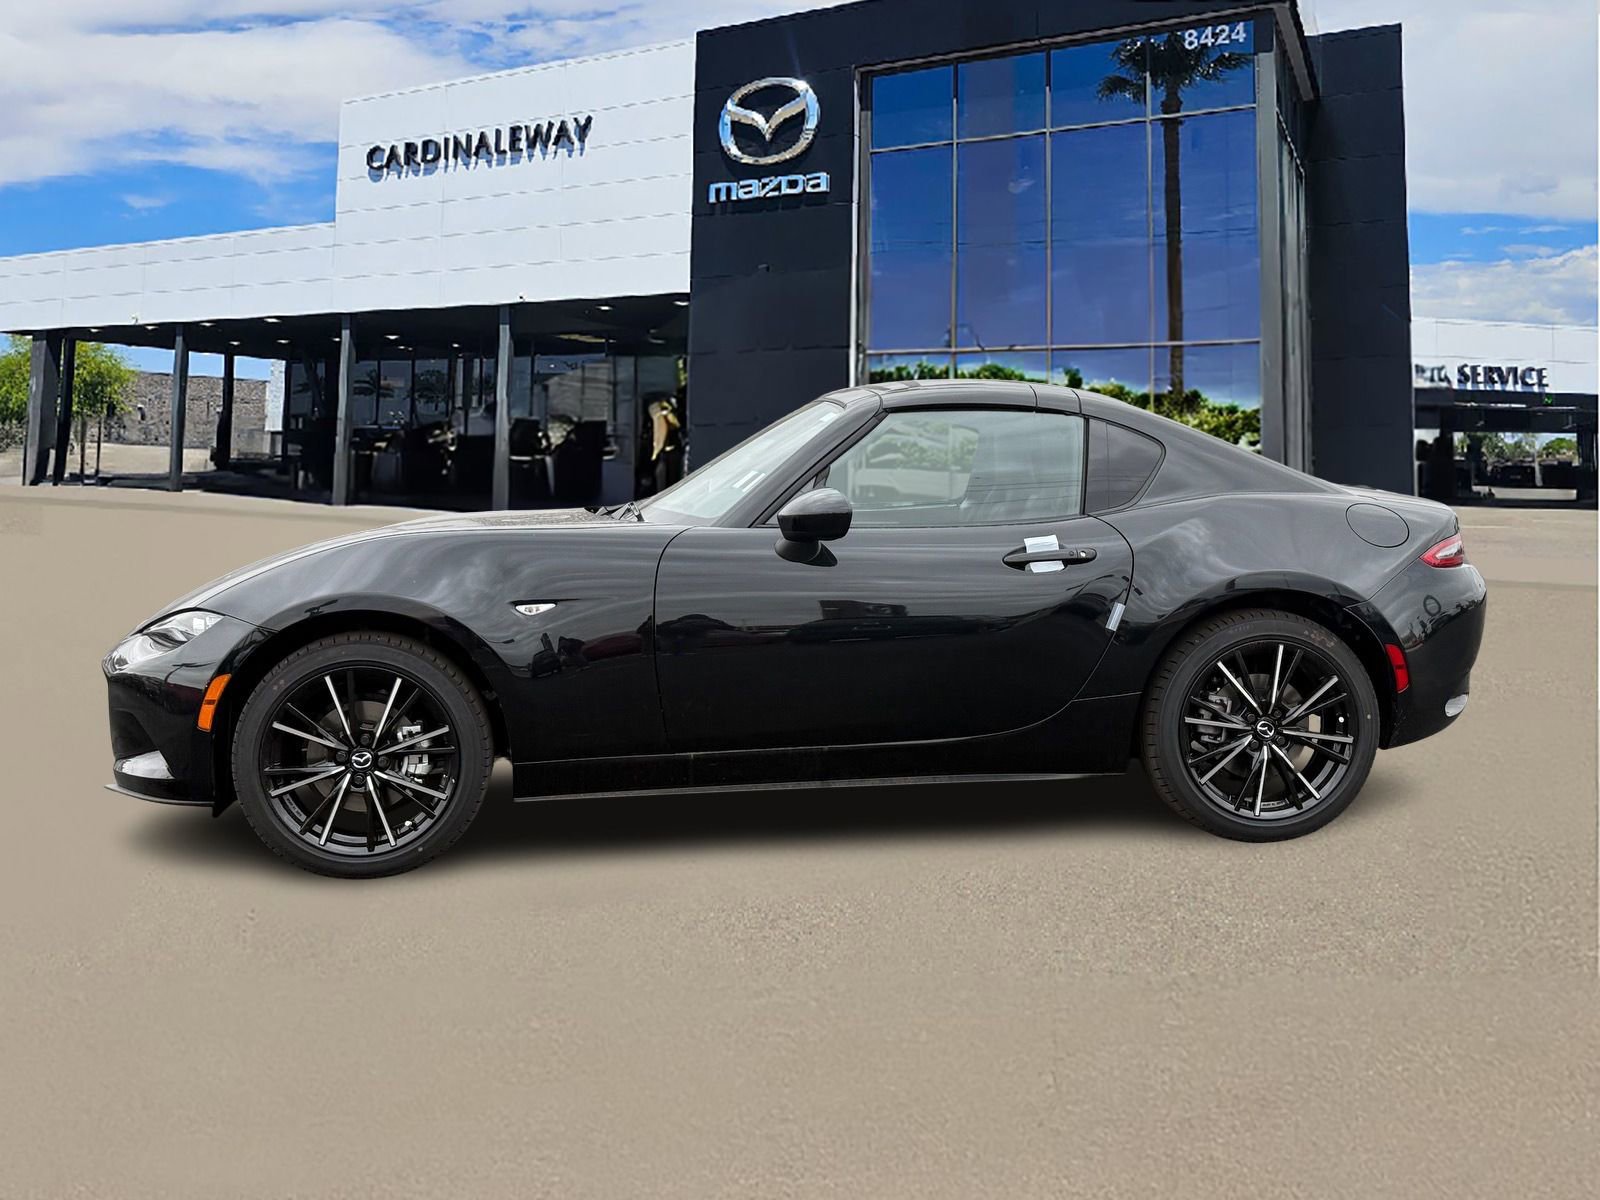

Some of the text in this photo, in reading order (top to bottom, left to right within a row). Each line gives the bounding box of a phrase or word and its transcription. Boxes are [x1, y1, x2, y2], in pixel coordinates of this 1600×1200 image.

[1184, 22, 1246, 50] 8424
[366, 115, 593, 170] CARDINALEWAY
[1457, 364, 1549, 388] SERVICE
